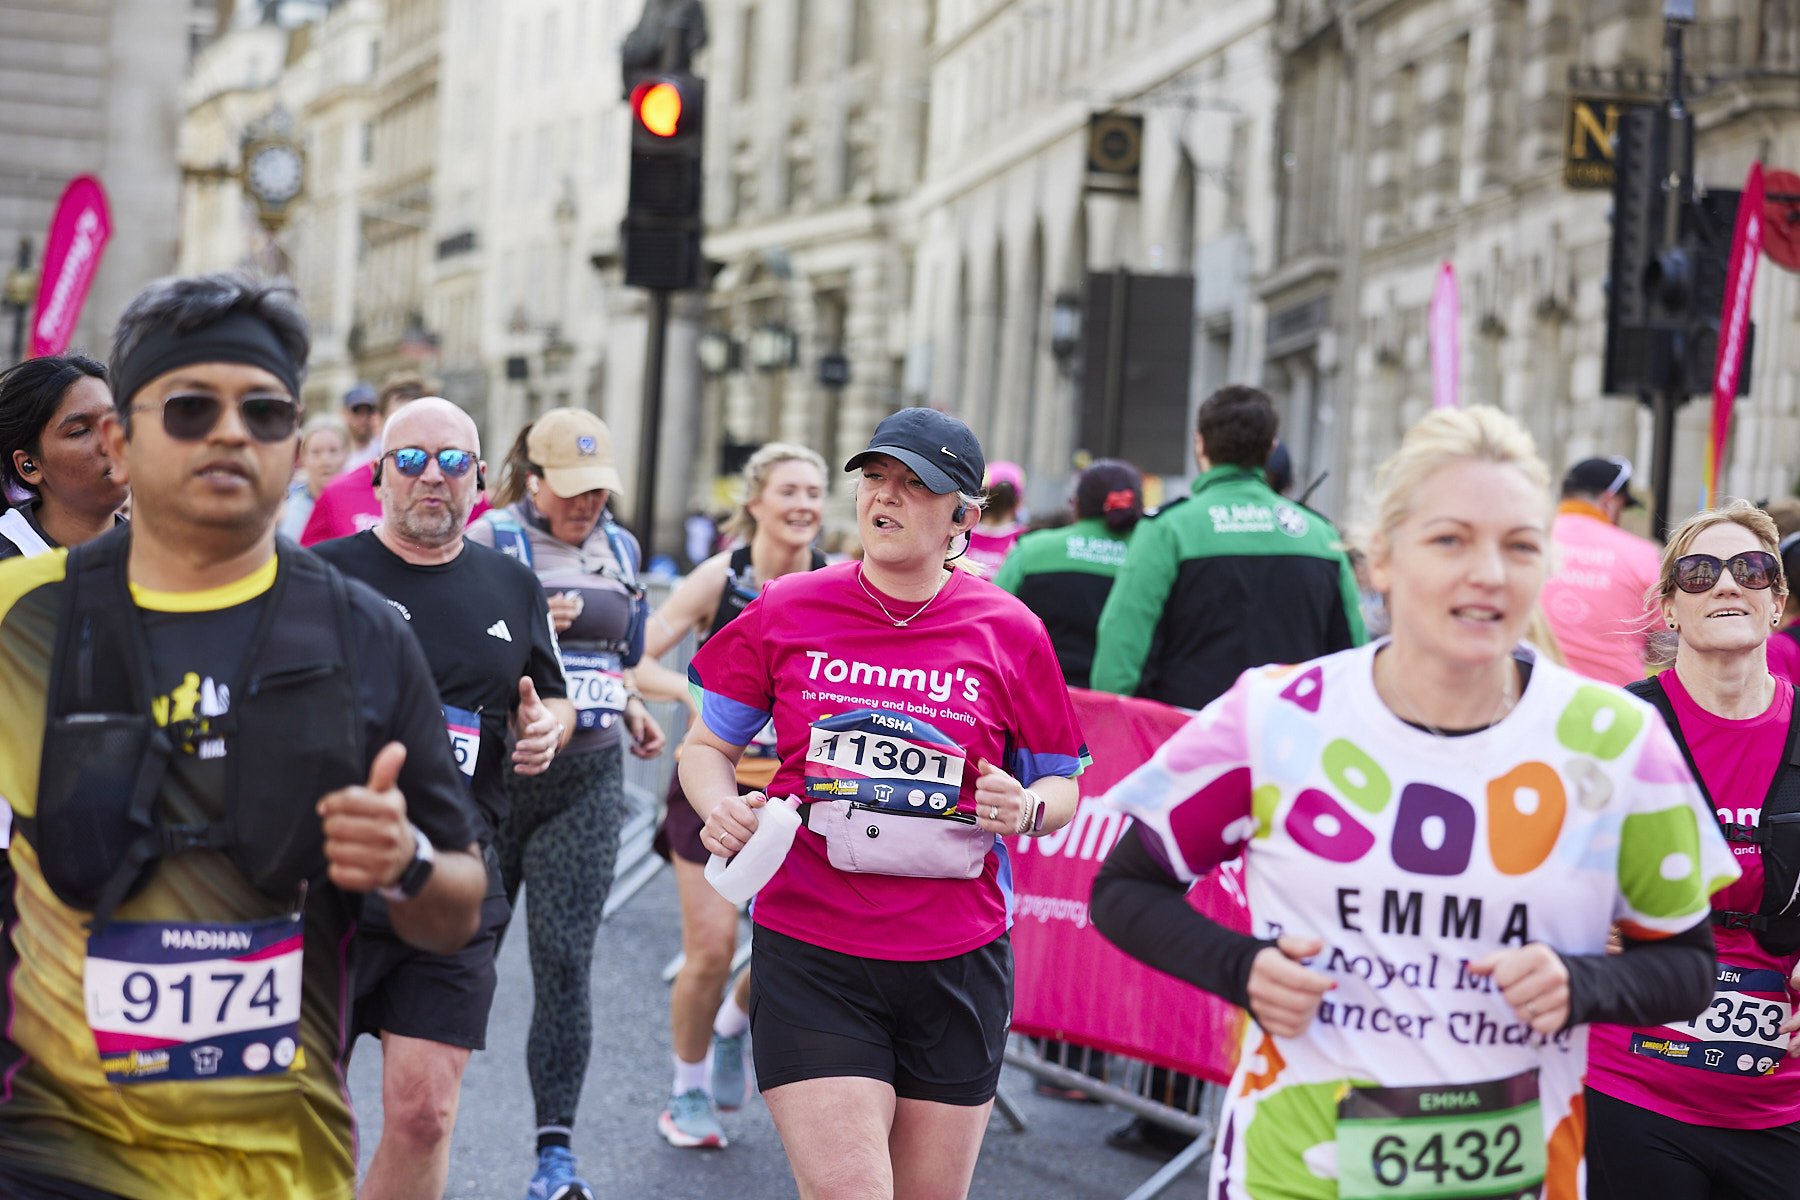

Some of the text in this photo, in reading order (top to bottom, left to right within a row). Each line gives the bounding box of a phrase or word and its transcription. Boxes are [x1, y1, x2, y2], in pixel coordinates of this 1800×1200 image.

[806, 650, 981, 702] Tommy's
[801, 689, 977, 727] The pregnancy and baby charity
[870, 713, 914, 734] TASHA
[823, 734, 948, 779] 11301
[161, 927, 253, 950] MADHAV
[1336, 888, 1529, 947] EMMA
[122, 968, 280, 1024] 9174
[1717, 970, 1742, 983] JEN
[1317, 1001, 1433, 1040] ancer
[1687, 997, 1784, 1042] 353
[1419, 1090, 1481, 1111] EMMA
[1372, 1123, 1525, 1187] 6432
